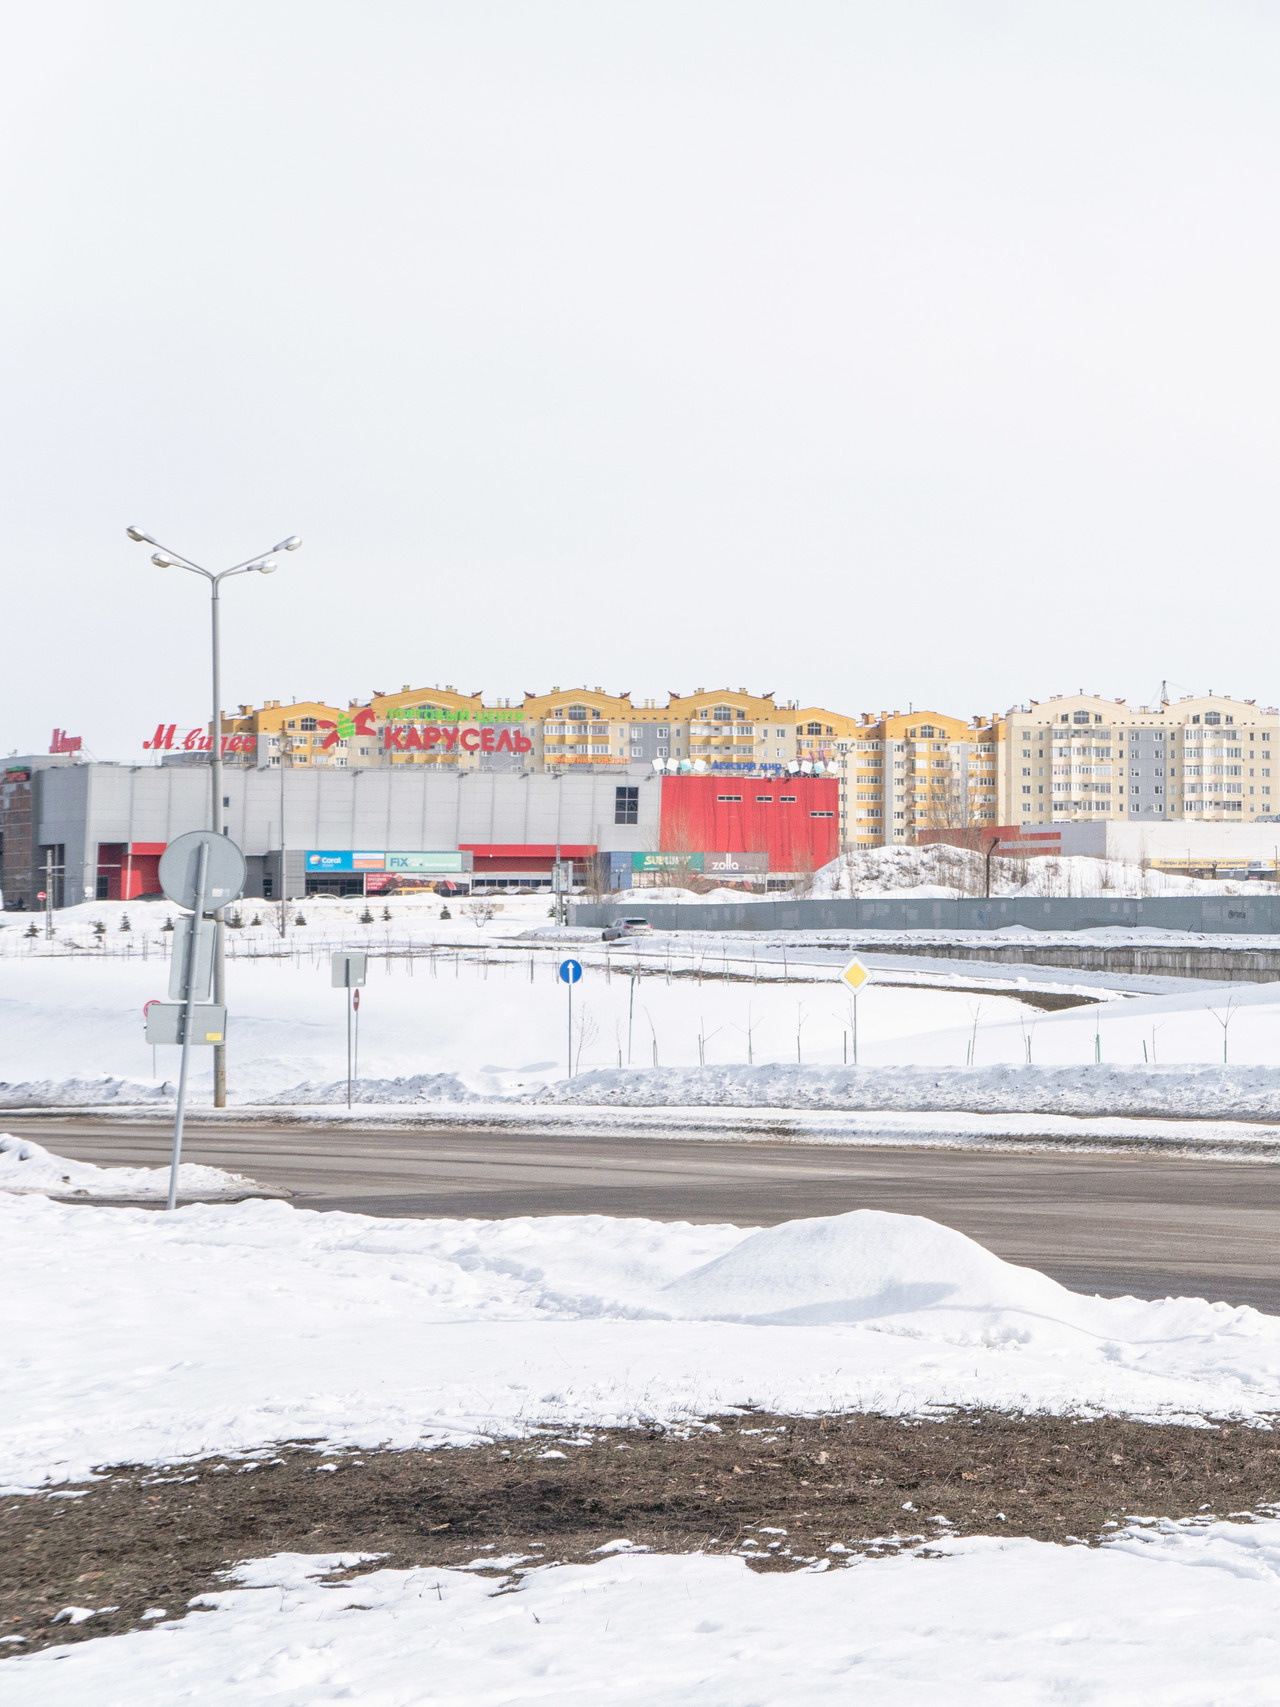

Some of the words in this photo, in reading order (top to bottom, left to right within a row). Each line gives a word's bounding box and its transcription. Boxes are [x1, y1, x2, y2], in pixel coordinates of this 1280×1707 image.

[387, 708, 470, 721] ТОРГОВЫЙ
[475, 710, 524, 725] ЦЕНТР
[384, 726, 532, 752] КАРУСЕЛЬ
[712, 853, 739, 870] zolla
